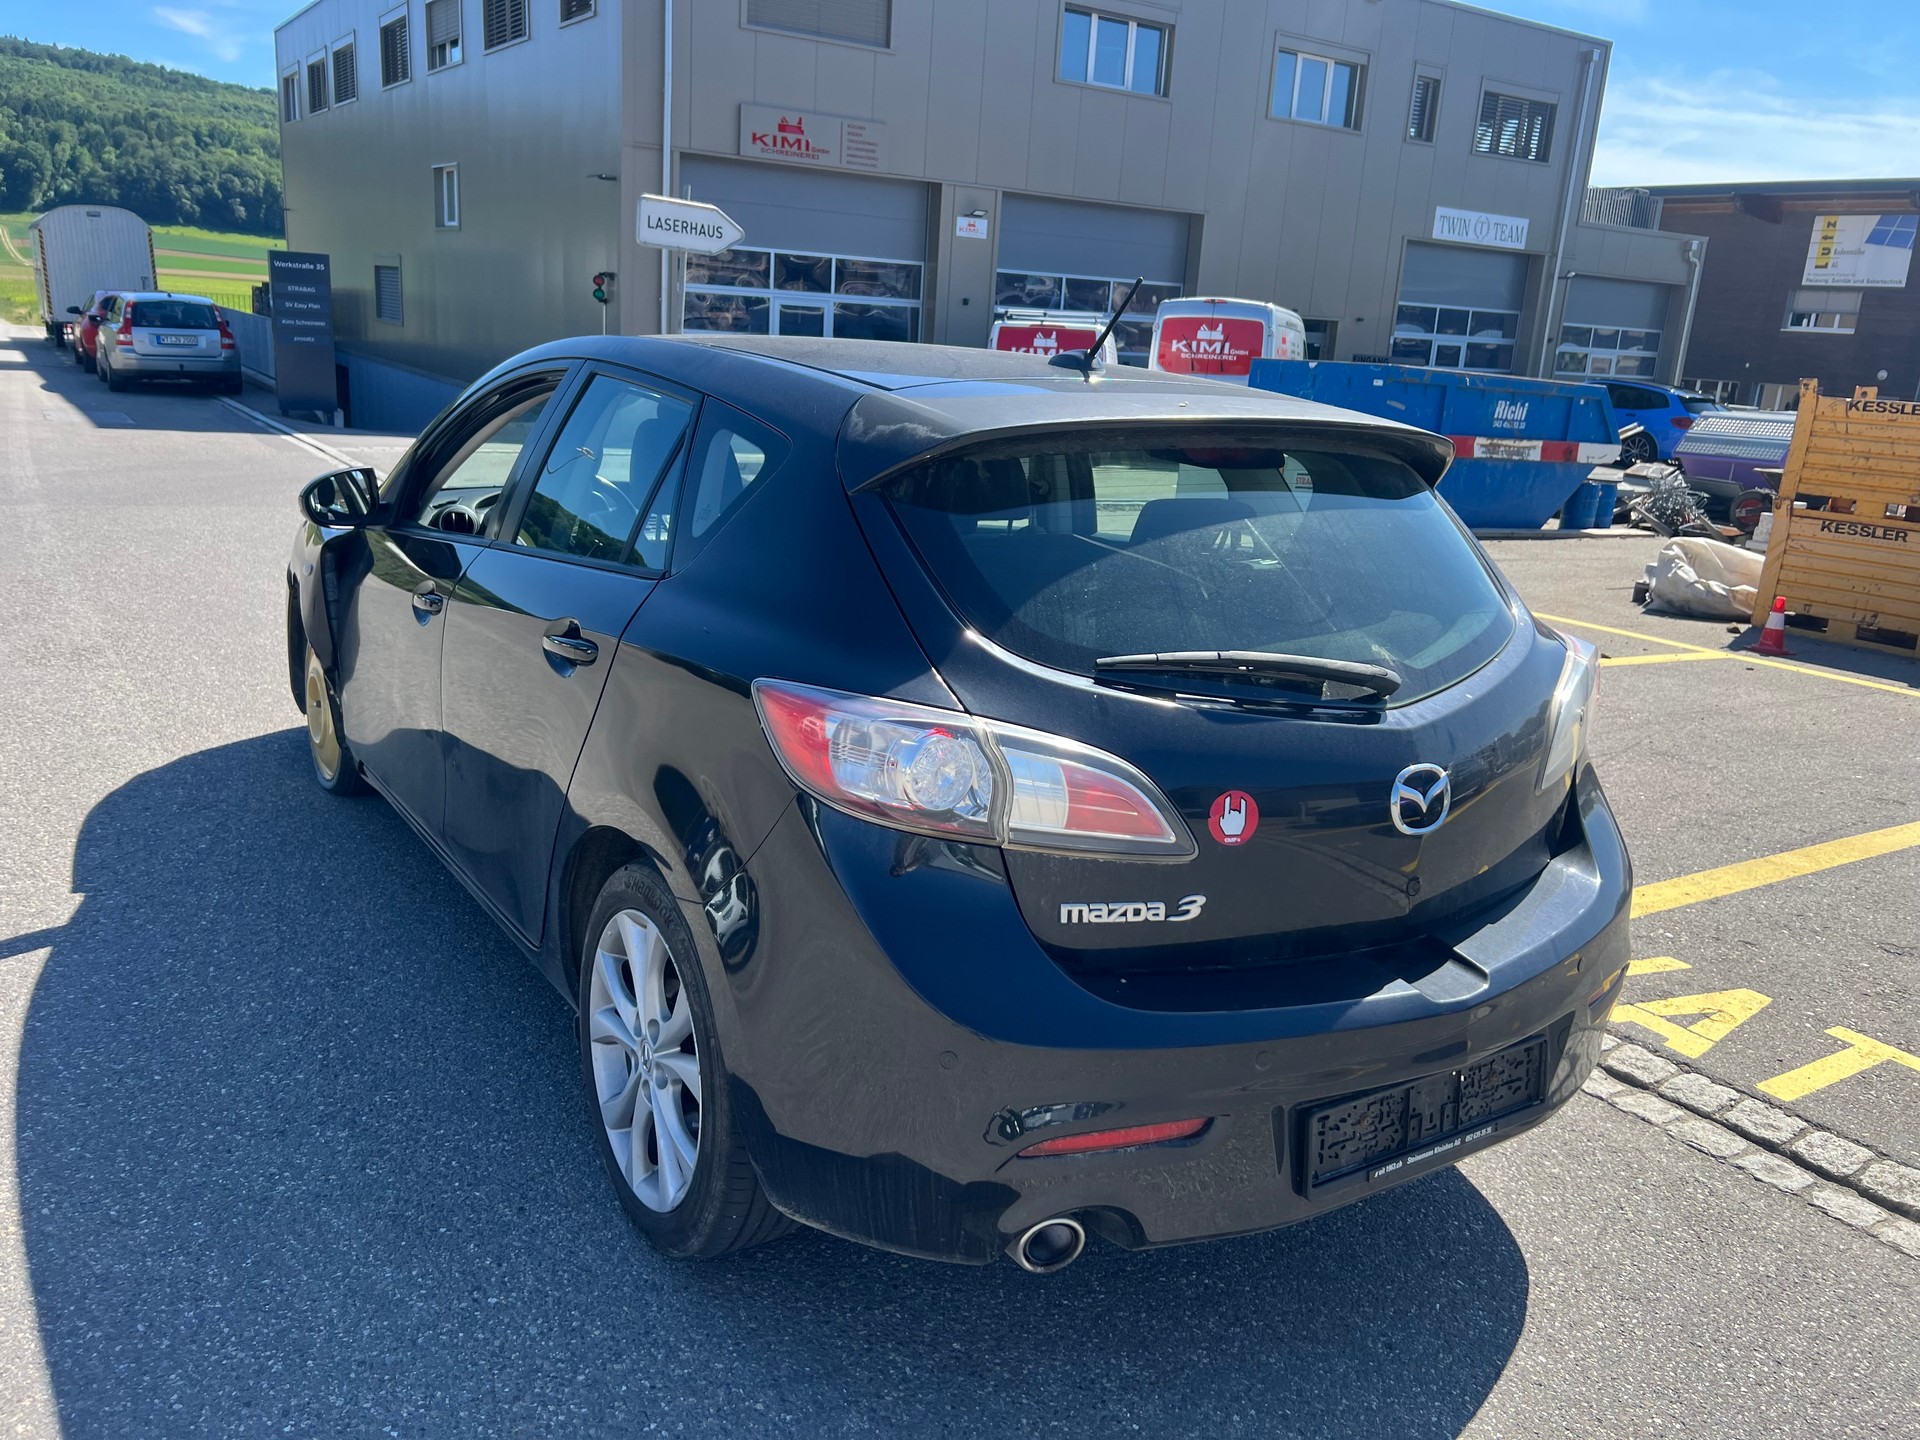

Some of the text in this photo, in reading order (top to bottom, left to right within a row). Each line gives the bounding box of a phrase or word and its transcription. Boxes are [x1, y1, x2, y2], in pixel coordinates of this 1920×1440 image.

[751, 132, 810, 152] KIMI
[760, 147, 820, 160] SCHREINEREI
[647, 215, 723, 239] LASERHAUS
[1440, 215, 1471, 237] TWIN
[1494, 222, 1525, 244] TEAM
[274, 260, 314, 270] Werkstraße
[1171, 339, 1230, 354] KIMI
[1494, 400, 1529, 421] Richi
[1820, 520, 1909, 542] KESSLER
[1060, 894, 1207, 924] mazda 3
